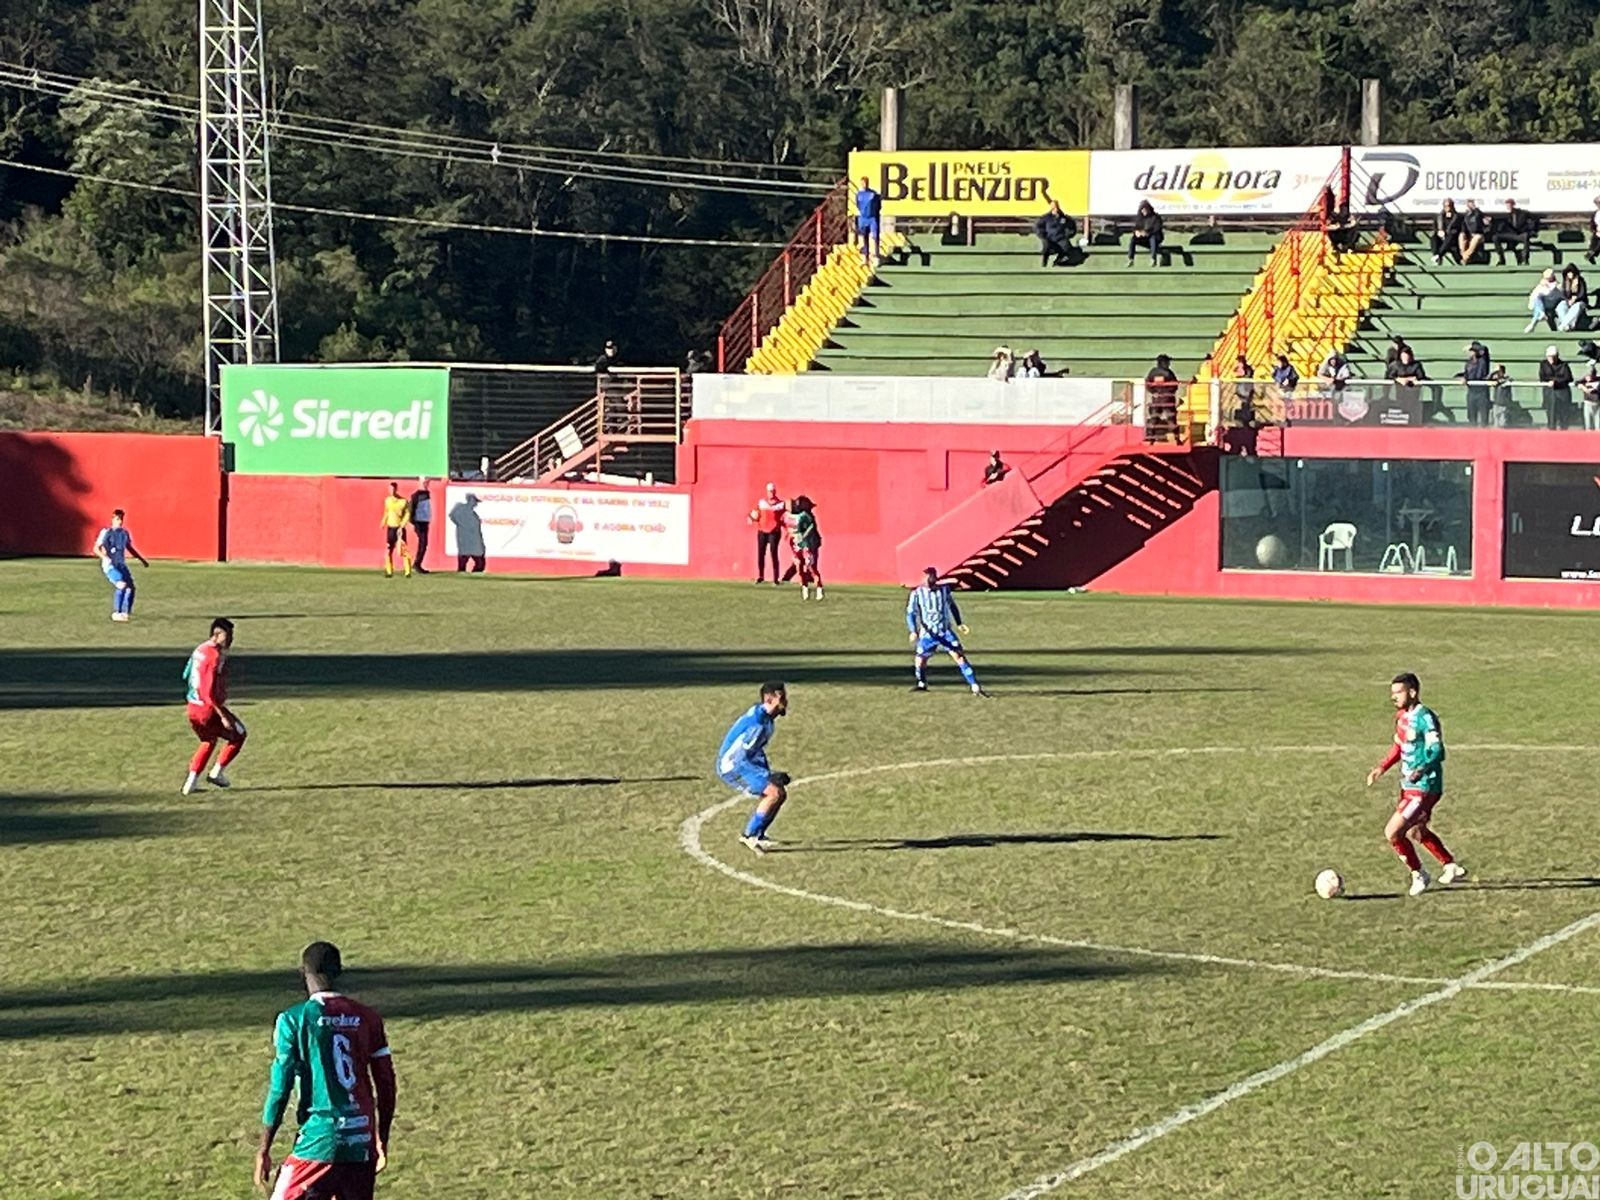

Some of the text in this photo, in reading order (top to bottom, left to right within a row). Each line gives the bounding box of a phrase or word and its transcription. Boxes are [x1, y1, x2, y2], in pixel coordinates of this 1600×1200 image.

[953, 161, 1011, 174] PNEUS
[1133, 165, 1282, 190] dalla nora
[1425, 170, 1519, 190] DEDO VERDE
[290, 399, 433, 439] Sicredi
[332, 1033, 357, 1090] 6
